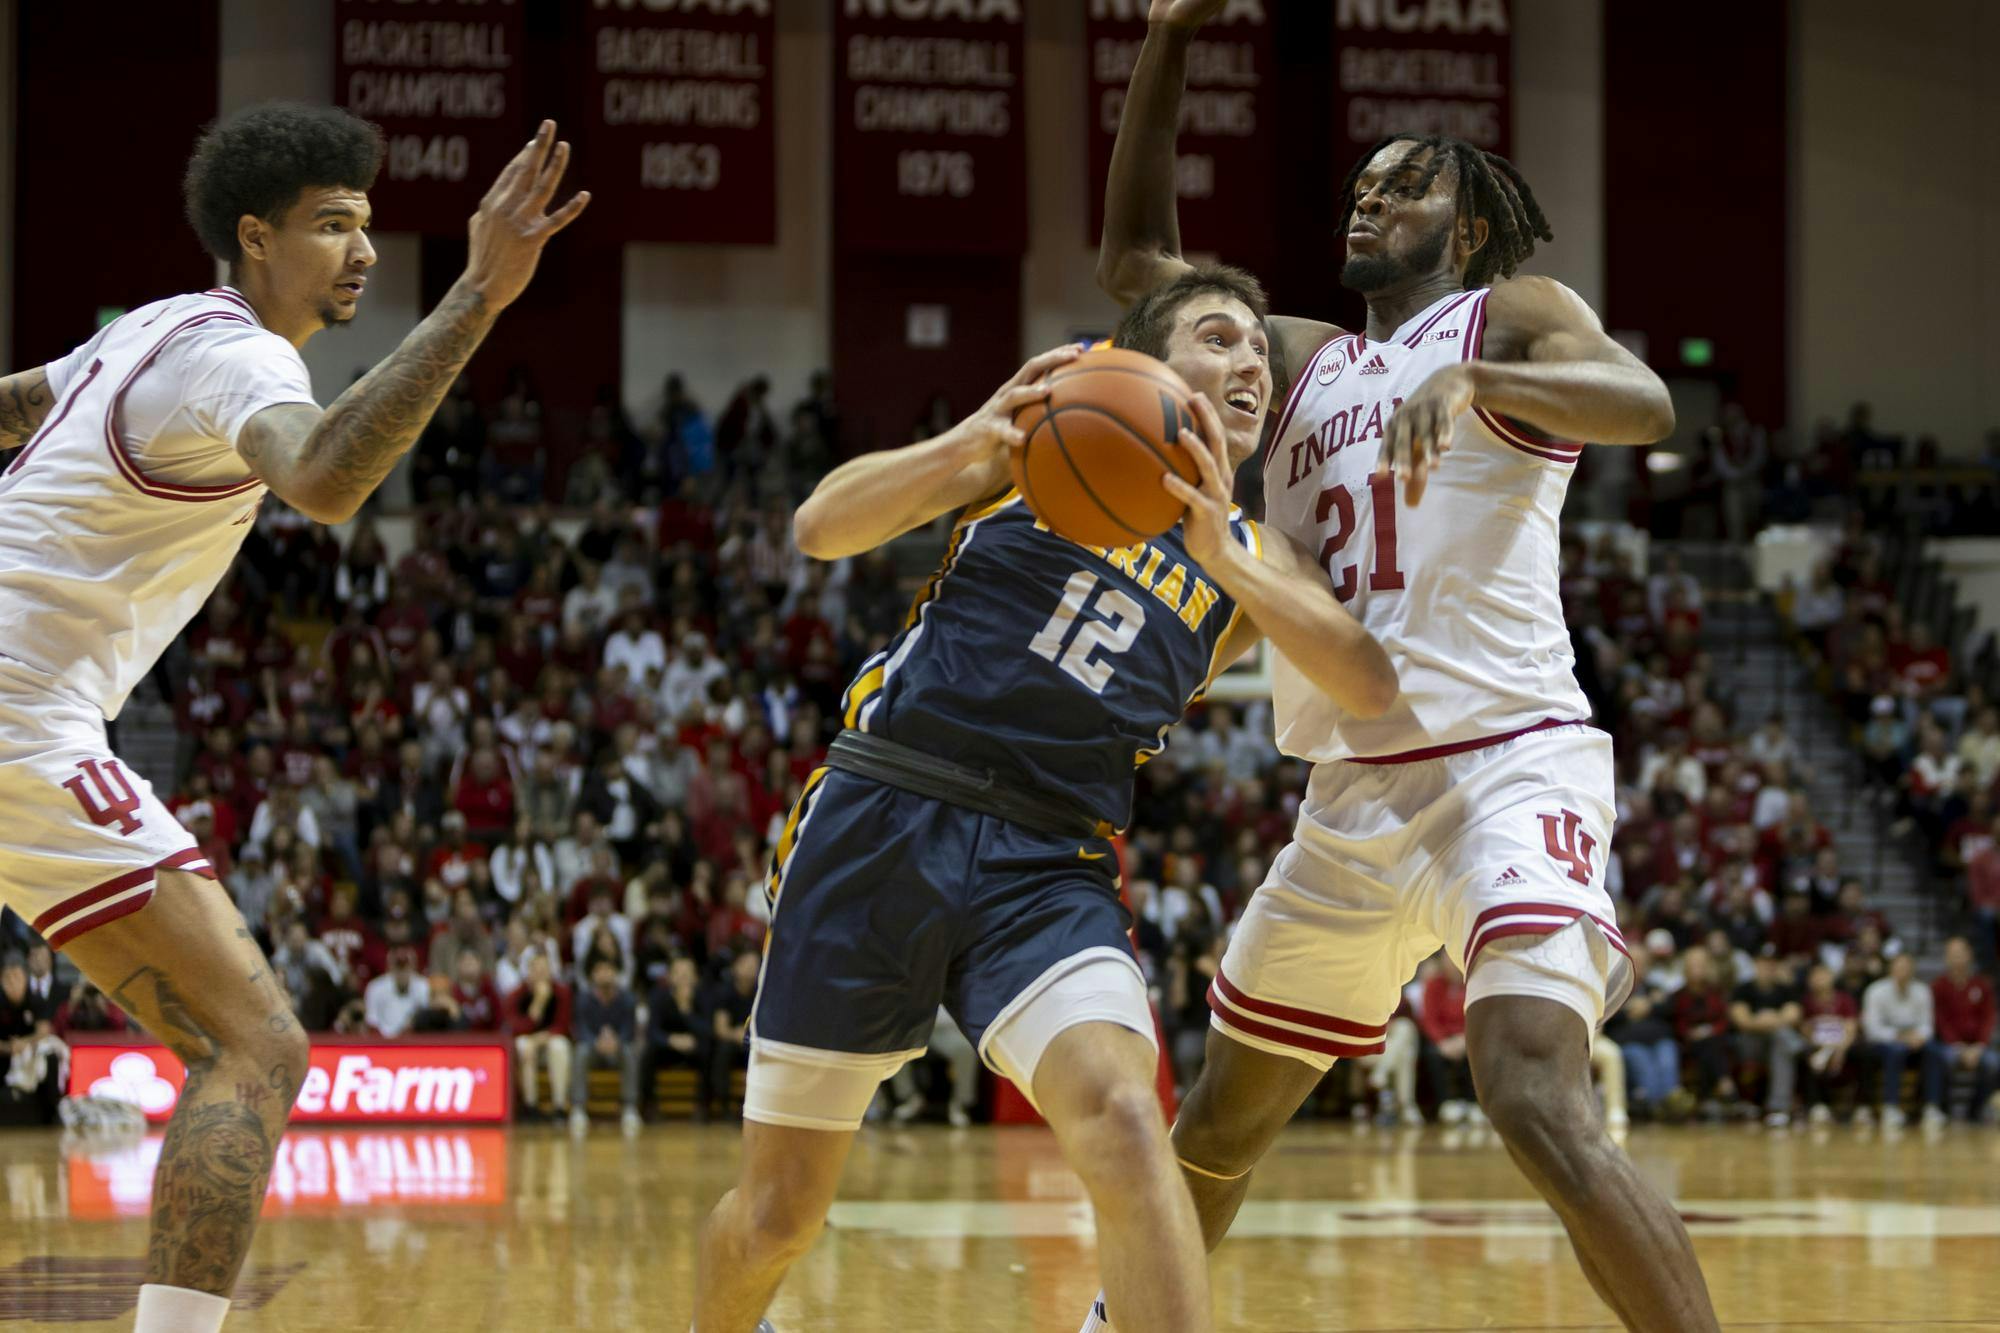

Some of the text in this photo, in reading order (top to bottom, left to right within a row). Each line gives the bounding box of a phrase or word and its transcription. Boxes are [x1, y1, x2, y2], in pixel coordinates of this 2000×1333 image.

[342, 19, 512, 67] BASKETBALL
[596, 27, 766, 78] BASKETBALL
[847, 33, 1017, 86] BASKETBALL
[348, 70, 505, 118] CHAMPIONS
[1339, 46, 1504, 97] BASKETBALL
[603, 79, 760, 129] CHAMPIONS
[854, 85, 1011, 137] CHAMPIONS
[388, 134, 469, 182] 1940
[897, 149, 975, 198] 1976
[1319, 360, 1342, 376] RMK
[1358, 366, 1389, 375] adidas
[1287, 398, 1404, 489] INDIA
[1315, 470, 1405, 603] 21
[1028, 570, 1146, 694] 12
